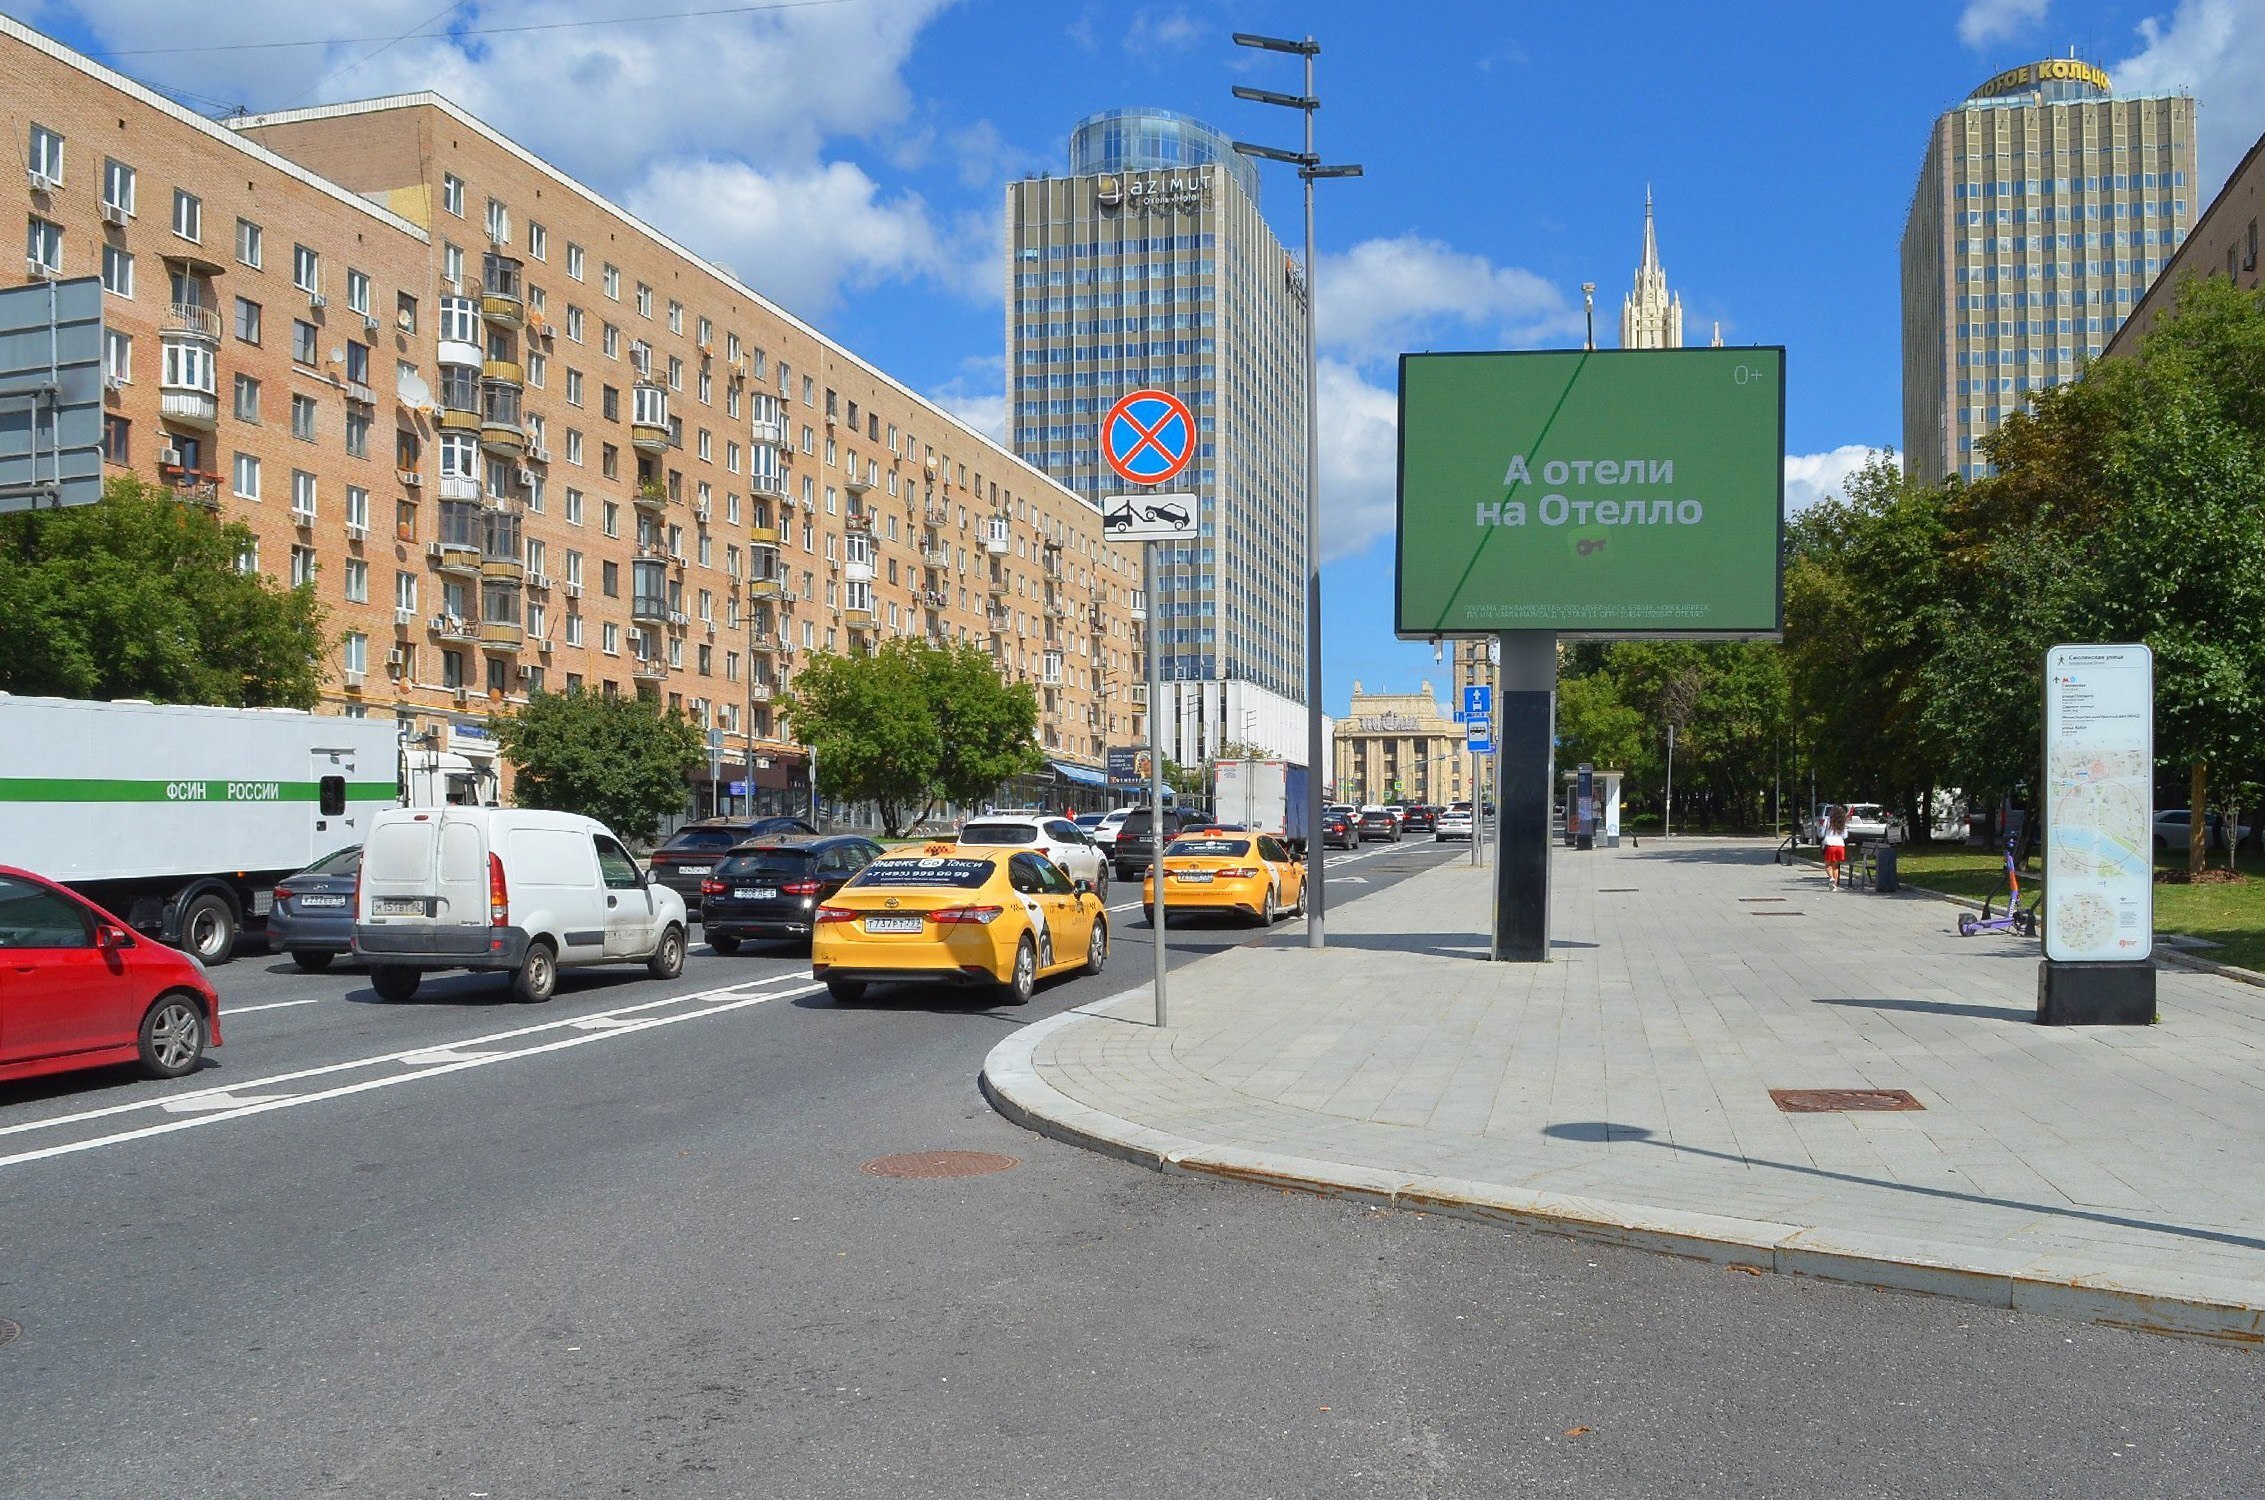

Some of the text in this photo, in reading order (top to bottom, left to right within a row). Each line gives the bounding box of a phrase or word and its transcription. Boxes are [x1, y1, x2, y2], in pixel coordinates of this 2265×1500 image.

[1974, 61, 2110, 99] ЛОТОЕ КОЛЬЦО
[1734, 365, 1764, 385] 0+
[1503, 454, 1674, 486] А отели
[1476, 493, 1703, 526] на Отелло
[166, 782, 279, 800] ФСИН РОССИИ
[947, 860, 983, 868] Такси
